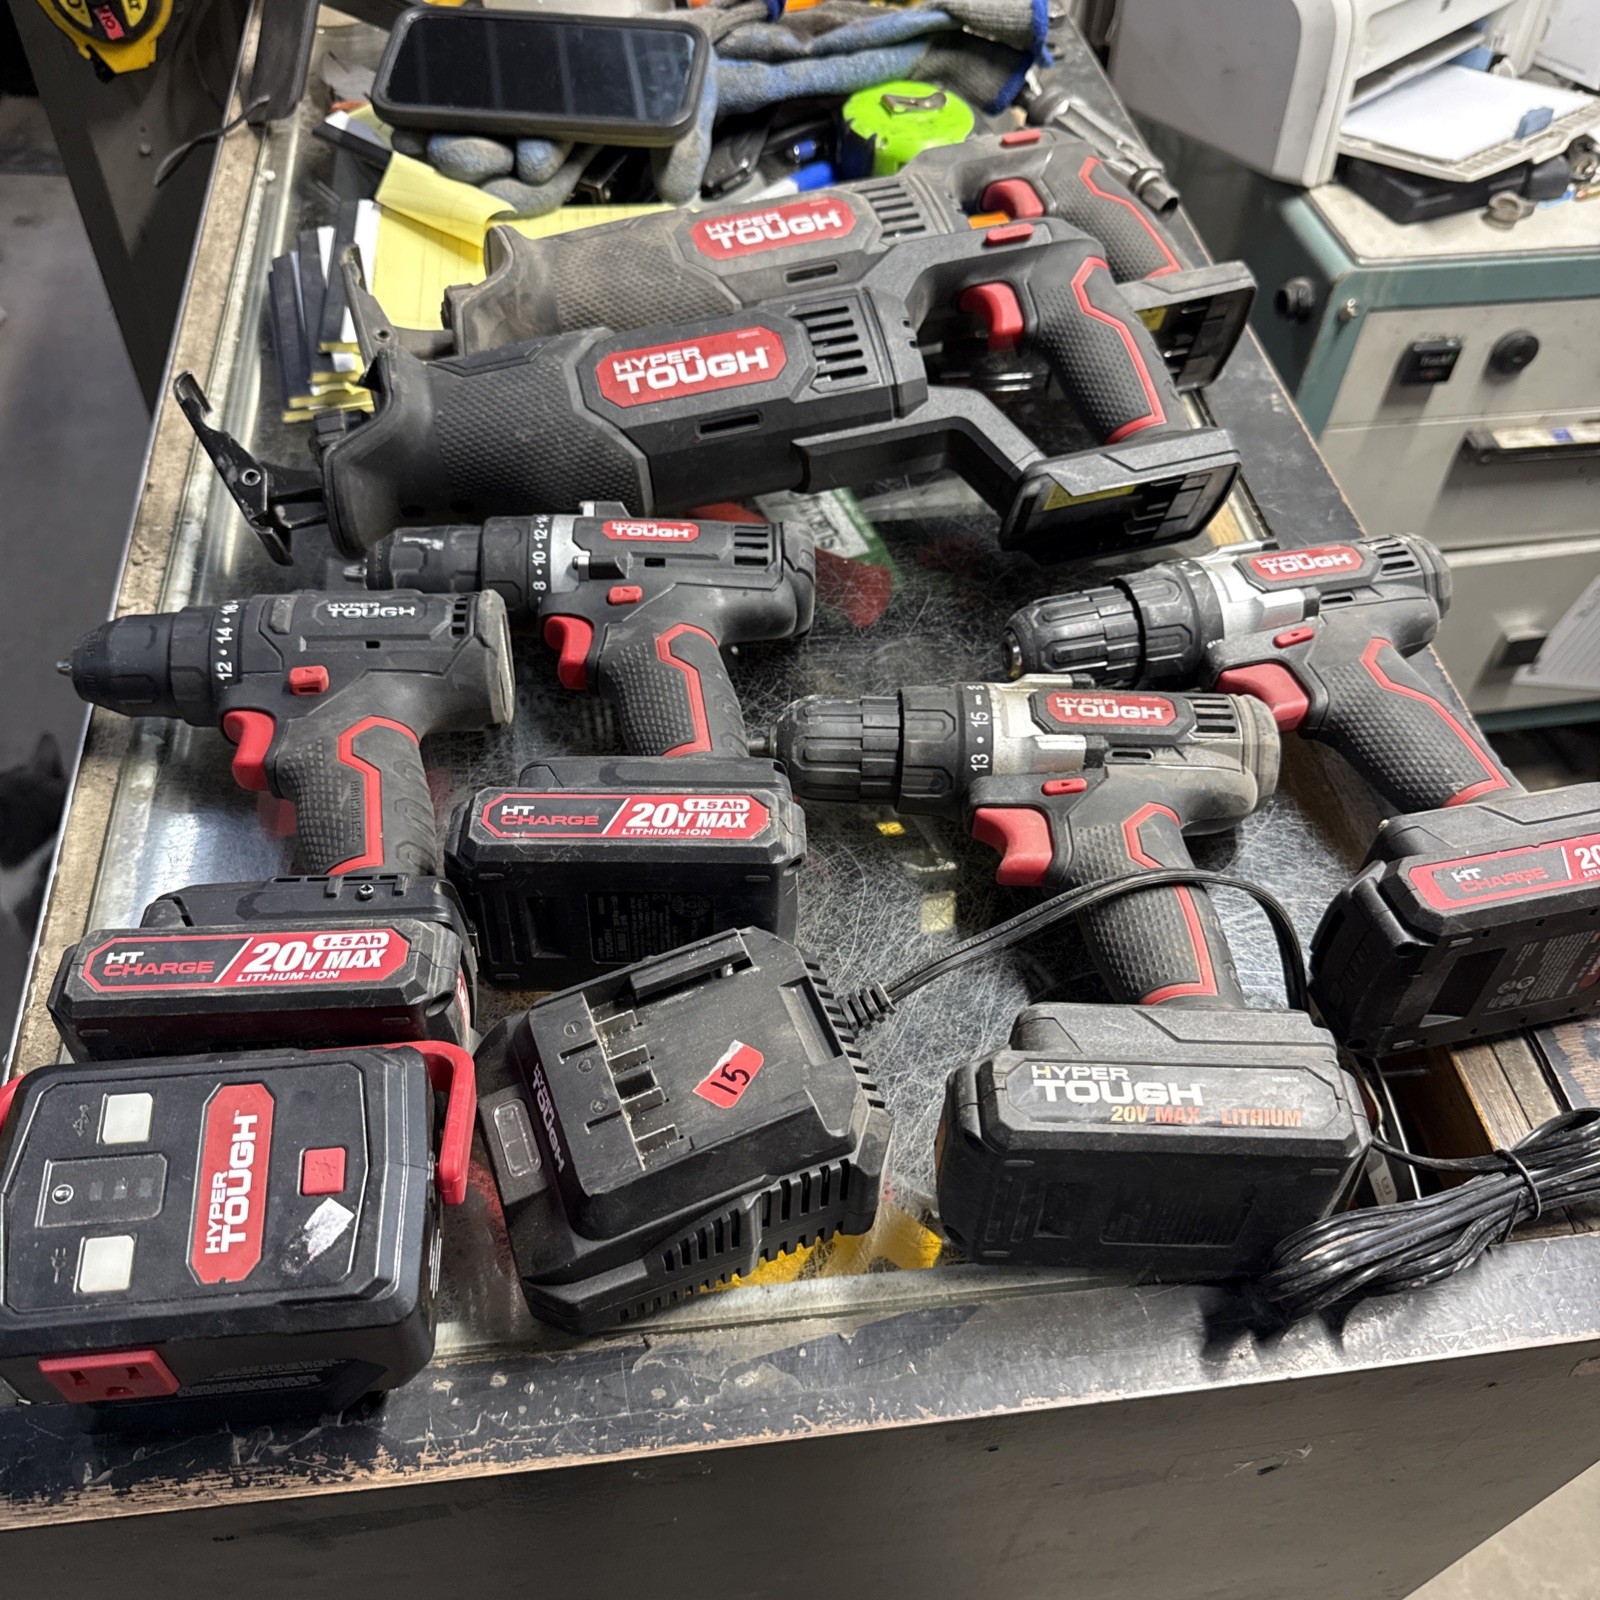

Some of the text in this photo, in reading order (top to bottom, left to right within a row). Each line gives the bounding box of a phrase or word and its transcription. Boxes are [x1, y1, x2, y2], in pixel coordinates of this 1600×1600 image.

[704, 211, 783, 236] HYPER
[709, 209, 843, 250] TOUGH
[612, 346, 702, 375] HYPER
[615, 346, 769, 395] TOUGH
[533, 528, 549, 542] 12
[614, 527, 690, 538] TOUGH
[531, 551, 547, 567] 10
[1260, 552, 1352, 576] TOUGH
[532, 580, 547, 591] 8
[326, 602, 381, 612] HYPER
[329, 606, 416, 619] TOUGH
[215, 627, 234, 645] 14
[215, 661, 233, 681] 12
[1055, 696, 1117, 706] HYPER
[970, 711, 989, 729] 15
[1057, 703, 1164, 720] TOUGH
[970, 752, 990, 773] 13
[501, 805, 535, 816] HT
[500, 815, 599, 826] CHARGE
[695, 812, 751, 829] MAX
[621, 828, 712, 837] LITHIUM-ION
[1451, 867, 1482, 883] HT
[1458, 866, 1550, 893] CHARGE
[105, 951, 145, 965] HT
[323, 949, 387, 971] MAX
[103, 961, 215, 978] CHARGE
[235, 970, 341, 983] LITHIUM-ION
[710, 1063, 752, 1096] 15
[1031, 1065, 1131, 1082] HYPER
[1032, 1079, 1205, 1107] TOUGH
[533, 1074, 565, 1174] TOUGH
[1110, 1105, 1303, 1127] 20V MAX LITHIUM
[219, 1113, 259, 1254] TOUGH
[204, 1170, 229, 1255] HYPER
